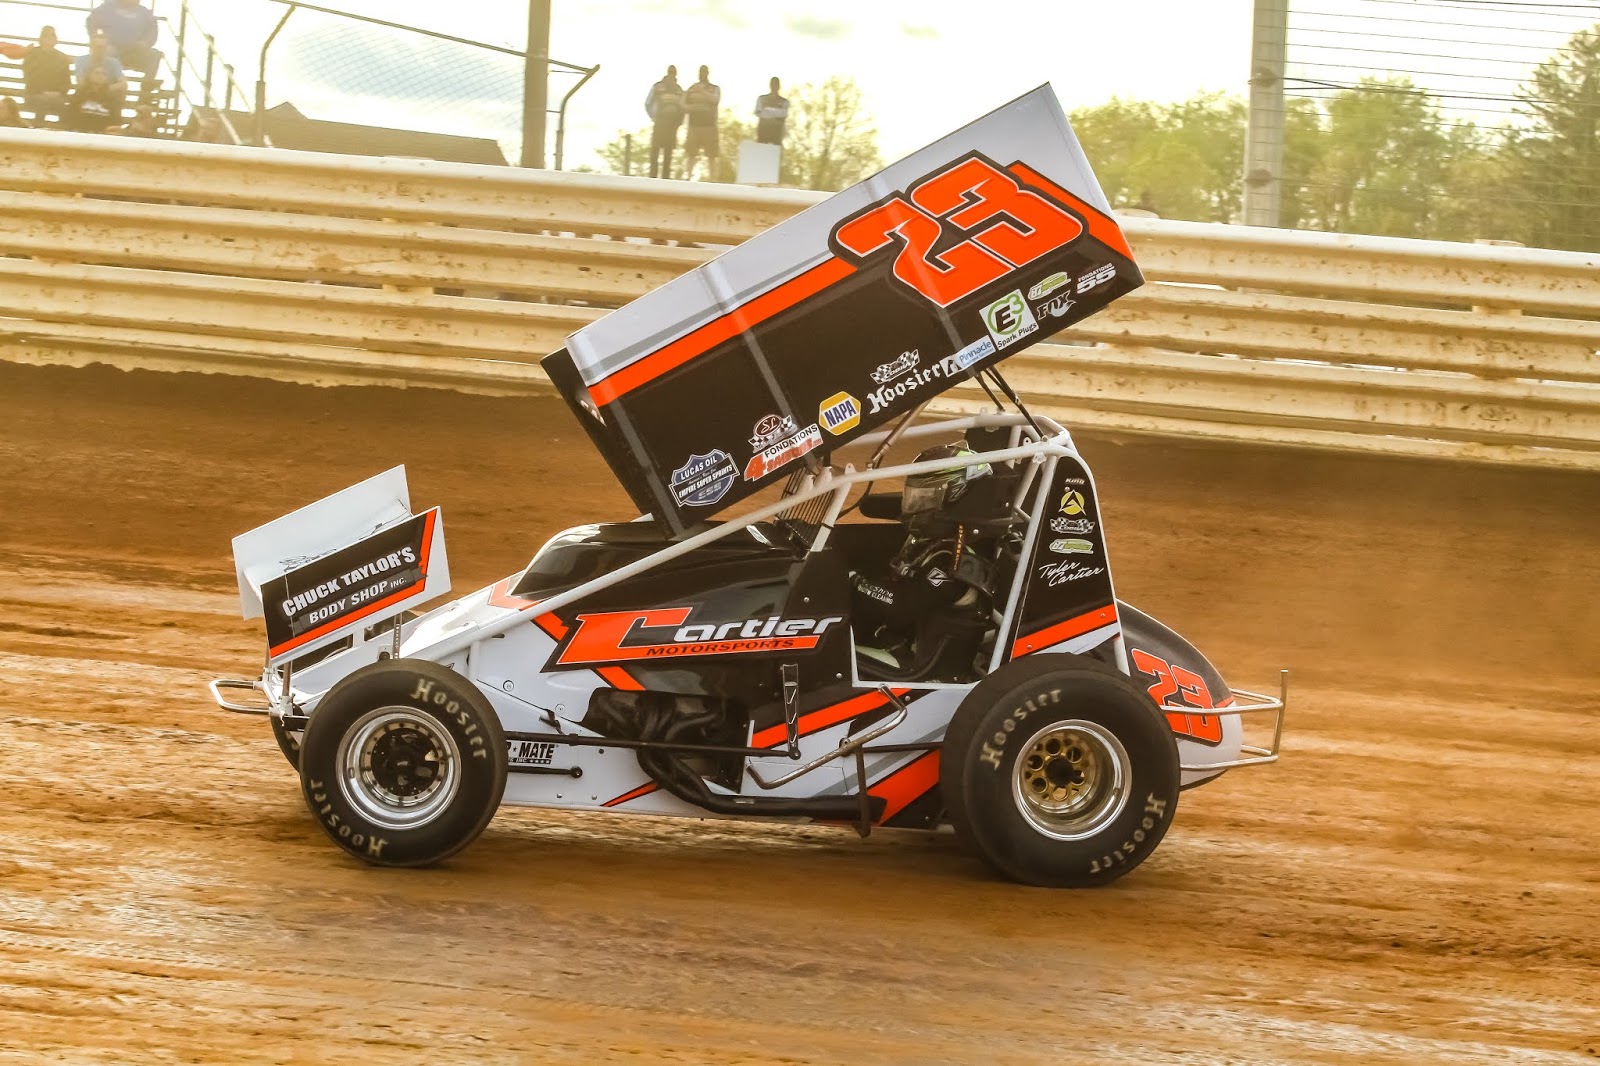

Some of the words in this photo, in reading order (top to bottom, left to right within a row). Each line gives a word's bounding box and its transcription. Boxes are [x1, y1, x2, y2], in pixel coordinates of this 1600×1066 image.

[836, 157, 1083, 308] 23
[1077, 270, 1116, 294] 55
[1037, 290, 1073, 320] FOX
[998, 333, 1017, 348] Spark
[1018, 322, 1037, 338] Plugs
[959, 341, 992, 363] Pinnacle
[867, 363, 941, 415] Hoosier
[824, 400, 857, 427] NAPA
[764, 424, 818, 458] FONDATIONS
[679, 483, 697, 498] EMPIRE
[696, 476, 713, 489] SUPER
[712, 464, 733, 480] SPRINTS
[680, 462, 704, 480] LUCAS
[705, 455, 717, 467] OIL
[746, 455, 766, 480] 4
[282, 578, 341, 617] CHUCK
[340, 546, 416, 586] TAYLOR'S
[1039, 560, 1080, 579] Tyler
[1048, 567, 1104, 587] Cartier
[309, 598, 346, 624] BODY
[350, 580, 388, 606] SHOP
[390, 577, 407, 589] INC.
[646, 639, 795, 656] MOTORSPORTS
[1131, 648, 1221, 743] 23
[410, 678, 488, 760] Hoosier
[979, 688, 1063, 772] Hoosier
[518, 742, 555, 760] MATE
[310, 778, 390, 858] Hoosier
[1089, 791, 1167, 874] Hoosier
